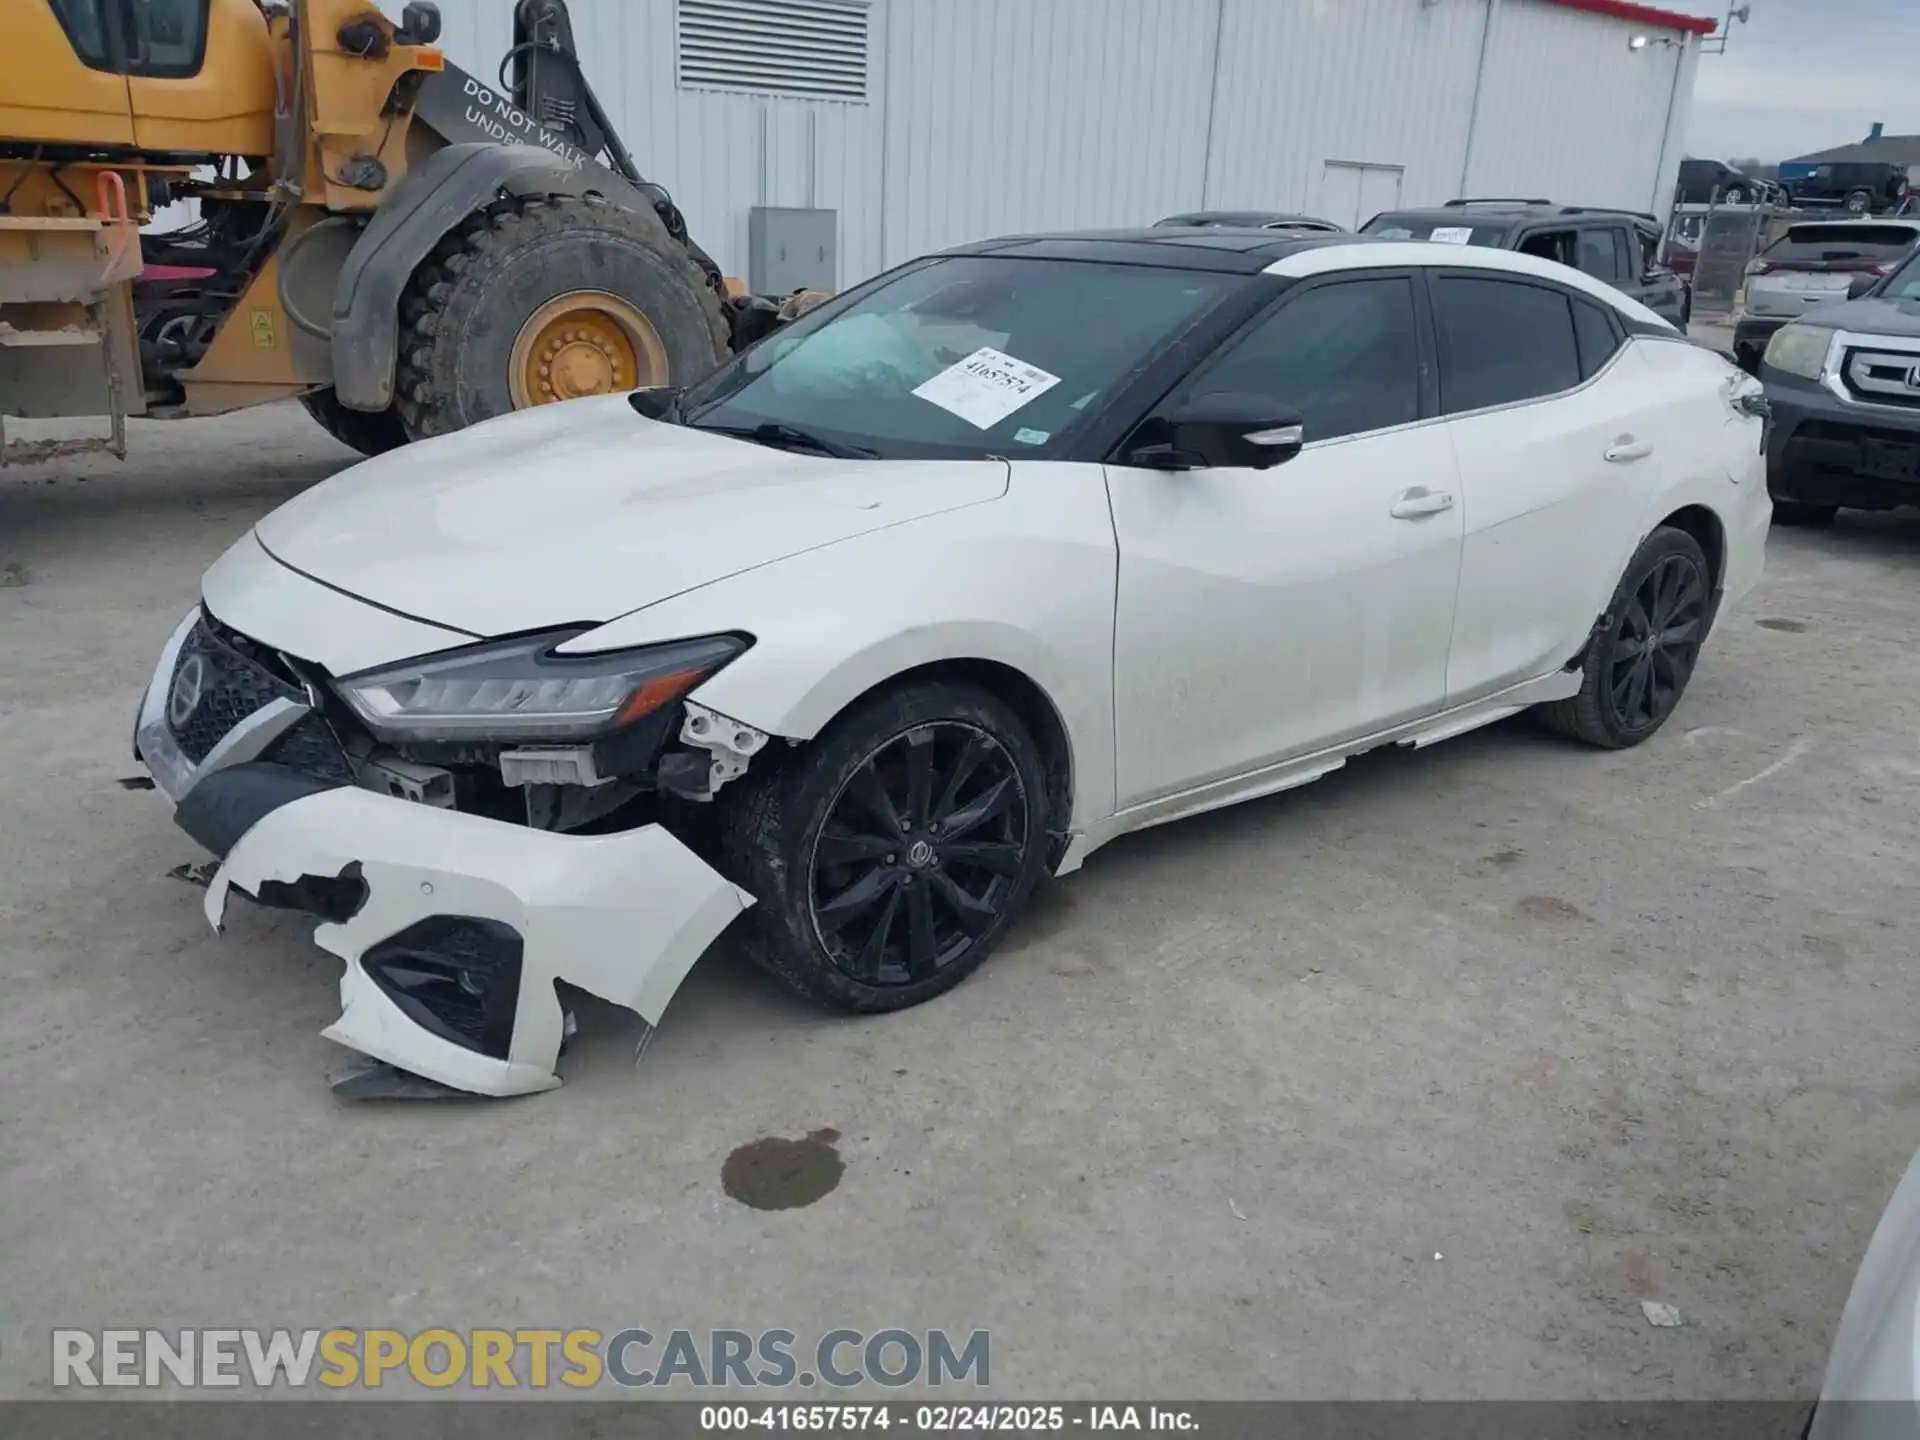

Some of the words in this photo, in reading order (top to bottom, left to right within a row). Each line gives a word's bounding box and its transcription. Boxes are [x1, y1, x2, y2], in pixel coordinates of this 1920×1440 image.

[463, 78, 493, 105] DO
[495, 101, 536, 133] NOT
[539, 127, 587, 170] WALK
